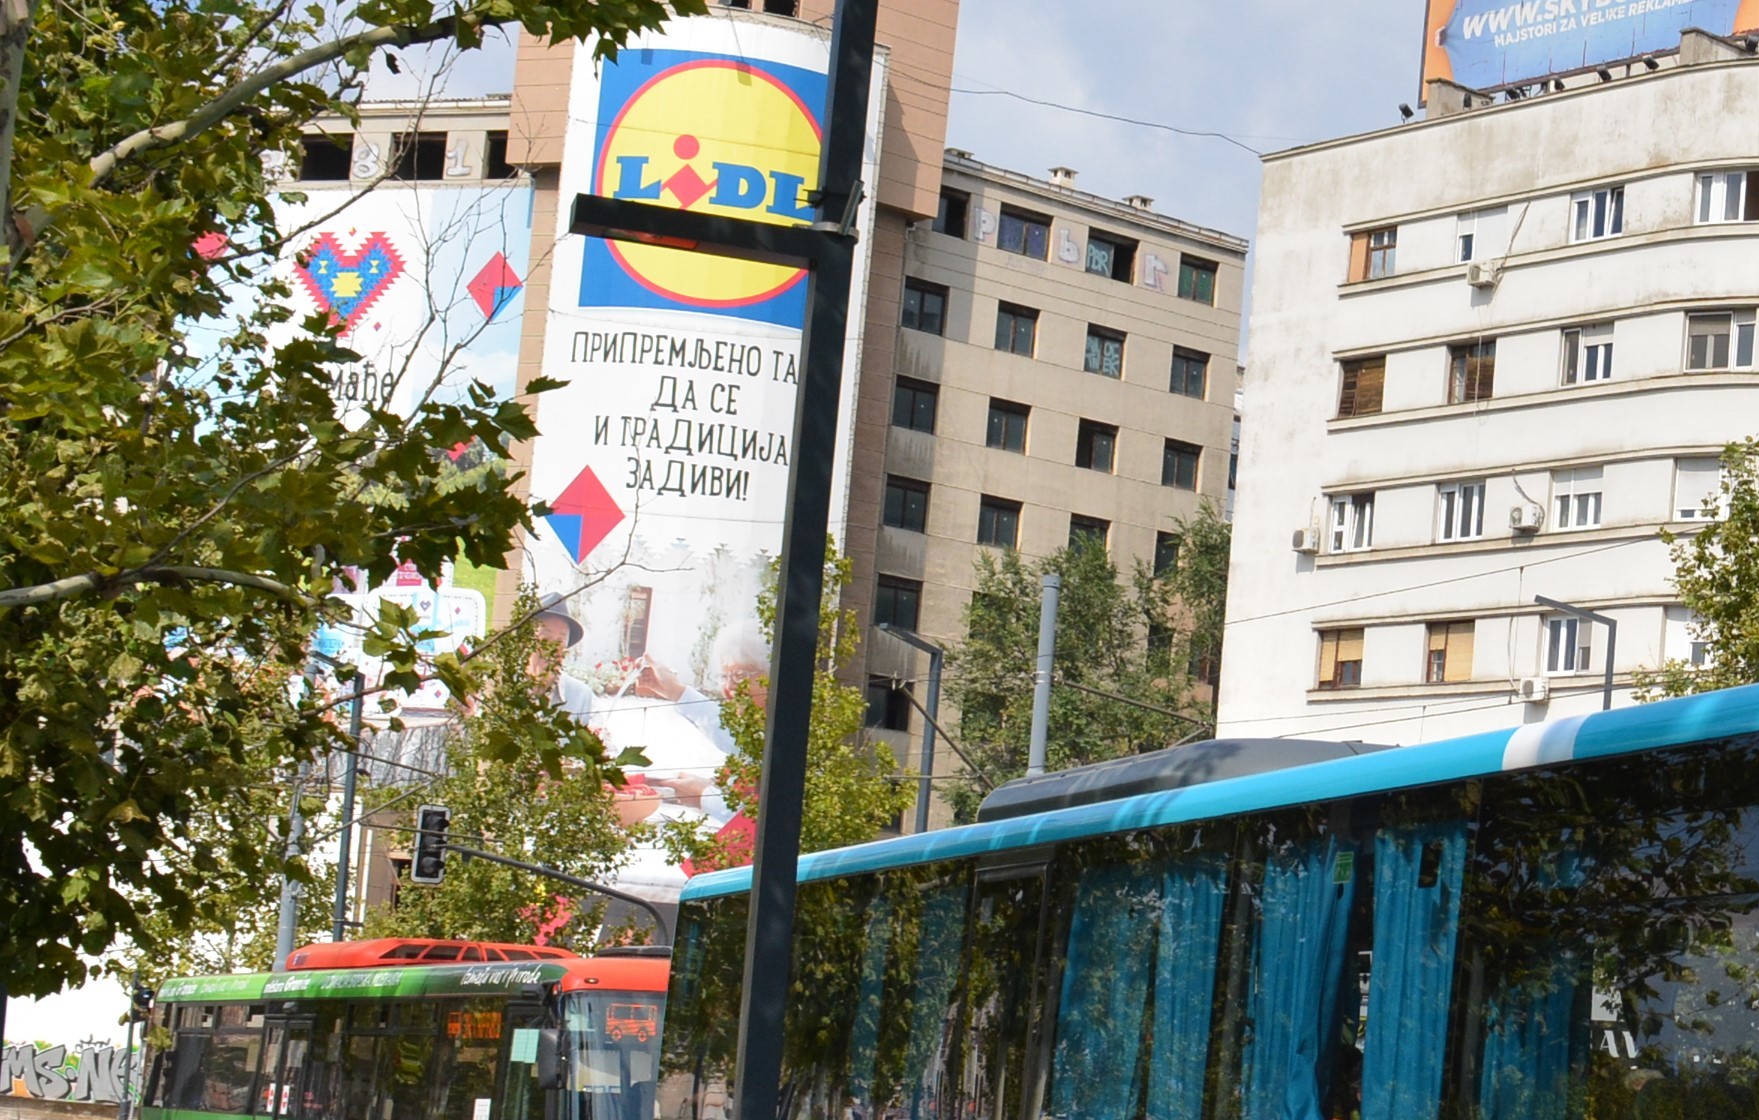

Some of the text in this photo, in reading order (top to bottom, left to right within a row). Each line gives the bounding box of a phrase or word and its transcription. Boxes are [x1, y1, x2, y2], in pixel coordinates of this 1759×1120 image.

[1494, 24, 1557, 47] MAJSTORI
[1560, 18, 1577, 31] ZA
[1581, 9, 1625, 27] VELIKE
[571, 331, 762, 378] ПРИПРЕМЉЕНО
[650, 375, 741, 416] ДА СЕ
[594, 415, 789, 467] И ТРАДИЦИЈА
[625, 456, 750, 502] ЗАДИВИ!
